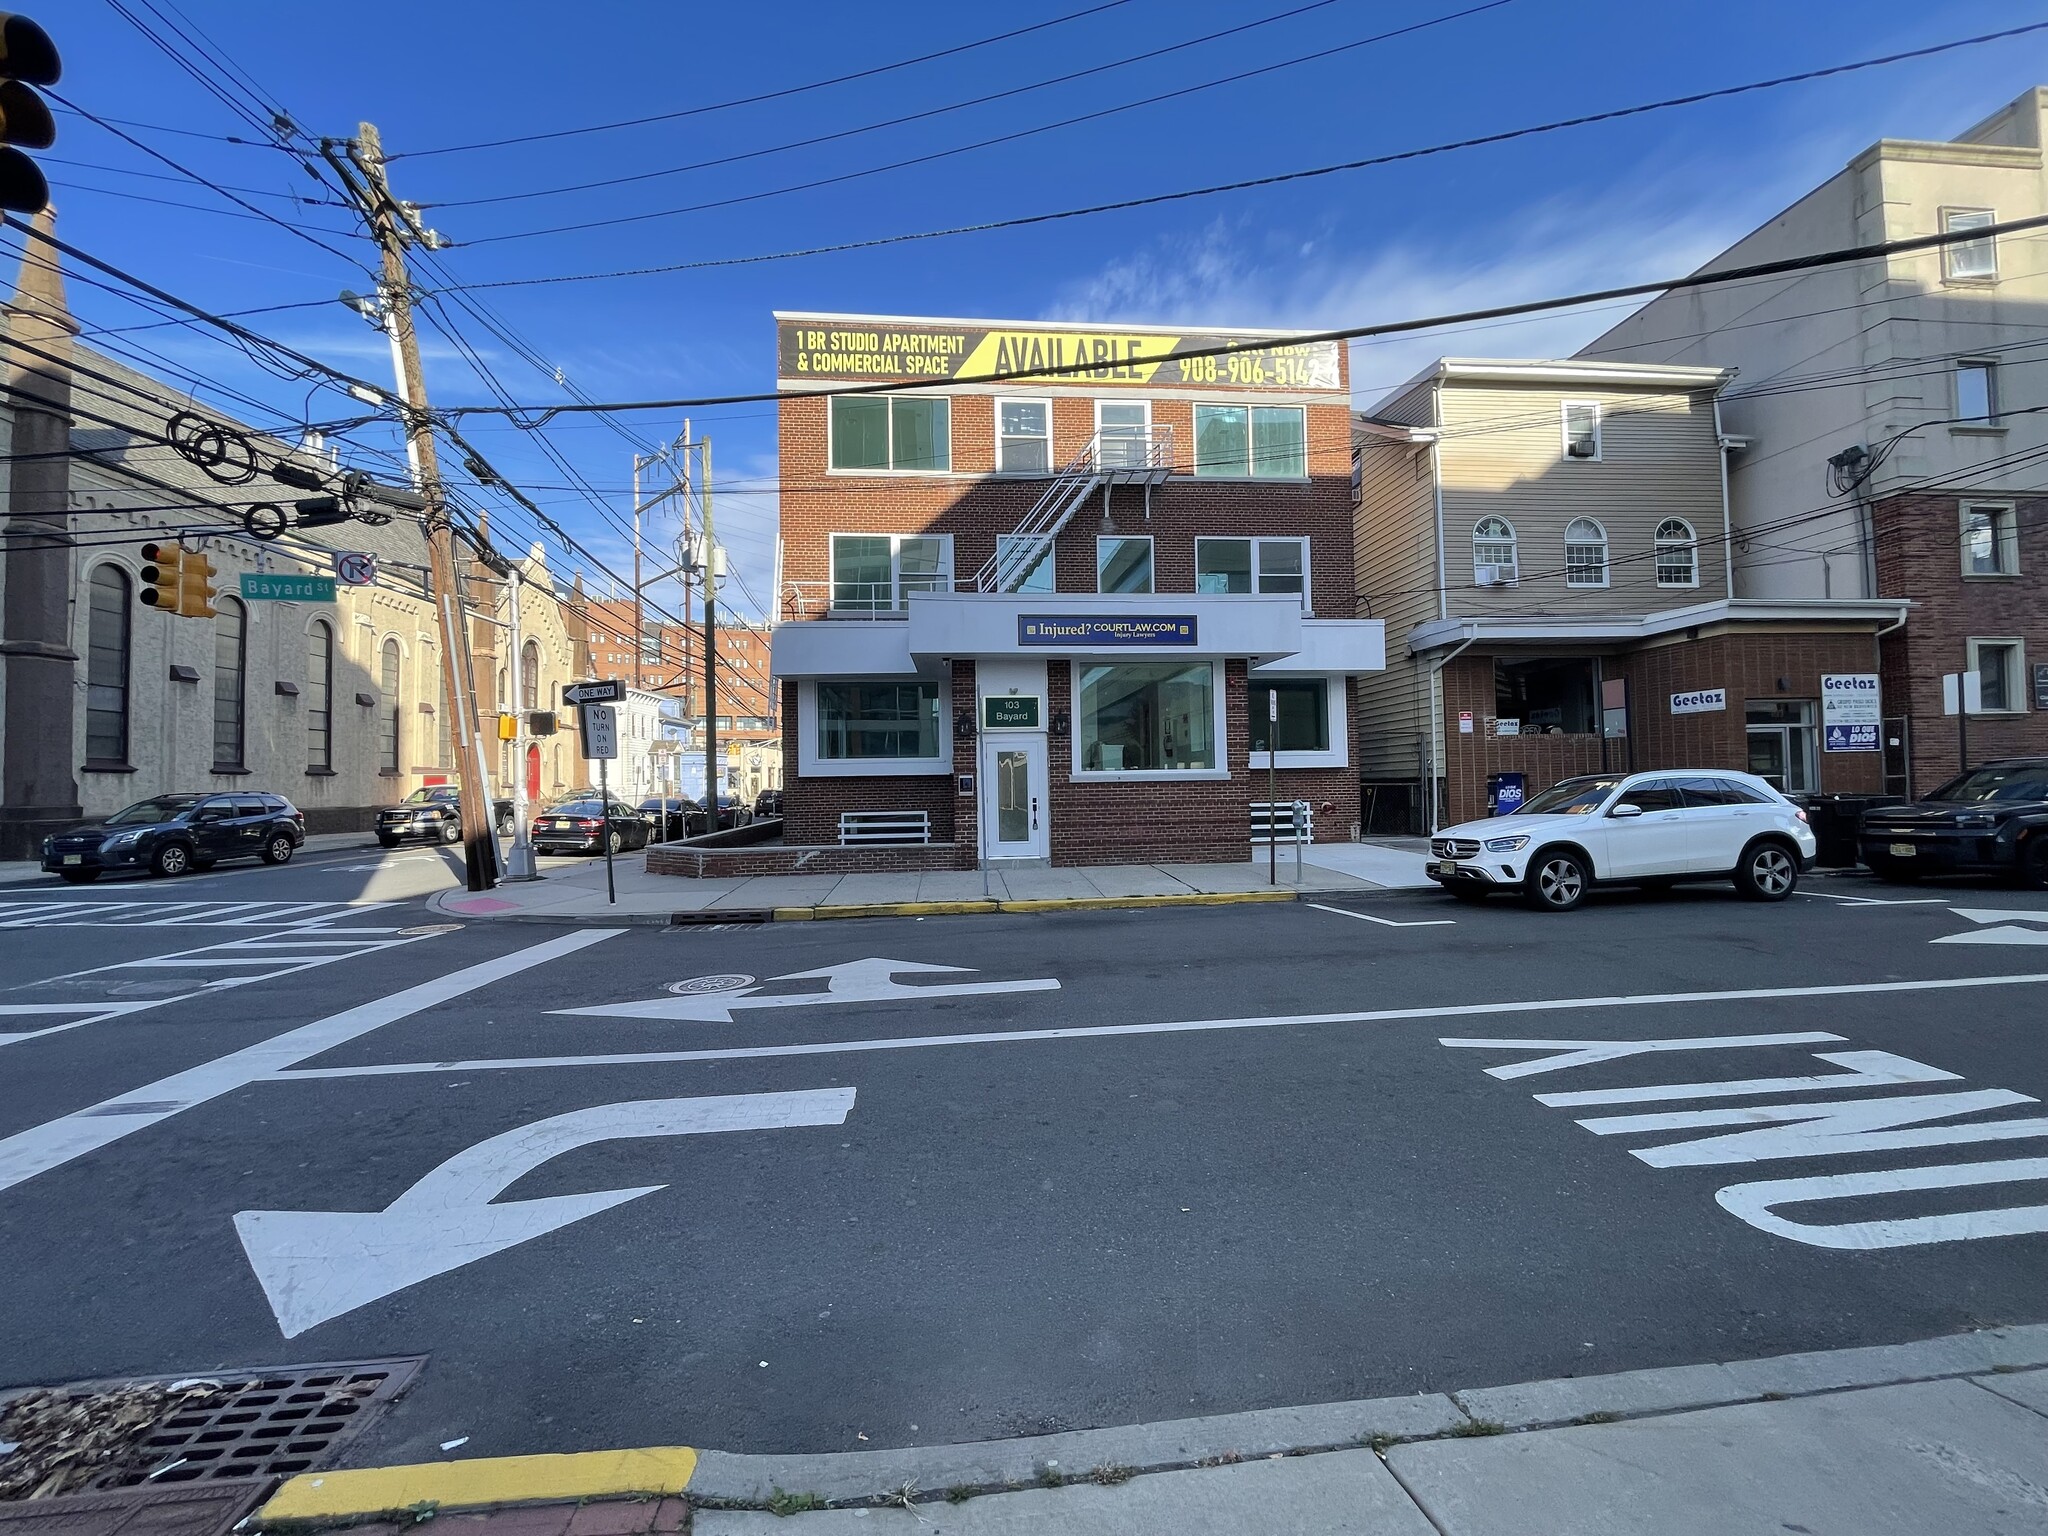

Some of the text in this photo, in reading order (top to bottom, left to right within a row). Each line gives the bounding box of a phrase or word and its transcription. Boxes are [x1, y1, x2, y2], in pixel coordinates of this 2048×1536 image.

[796, 331, 965, 354] 1 BR STUDIO APARTMENT
[994, 336, 1143, 379] AVAILABLE
[797, 353, 949, 374] & COMMERCIAL SPACE
[1180, 355, 1320, 386] 908-906-5142
[247, 580, 329, 597] Bayard St
[1039, 623, 1176, 638] Injured? COURTLAW.COM
[1824, 677, 1876, 690] Geetaz
[579, 687, 612, 698] ONE WAY
[1004, 701, 1020, 709] 103
[1673, 692, 1723, 707] Geetaz
[593, 710, 607, 720] NO
[996, 712, 1028, 721] Bayard
[592, 722, 610, 731] TURN
[596, 734, 607, 742] ON
[1849, 732, 1877, 742] DIOS
[596, 746, 609, 754] RED
[1499, 788, 1522, 798] DIOS
